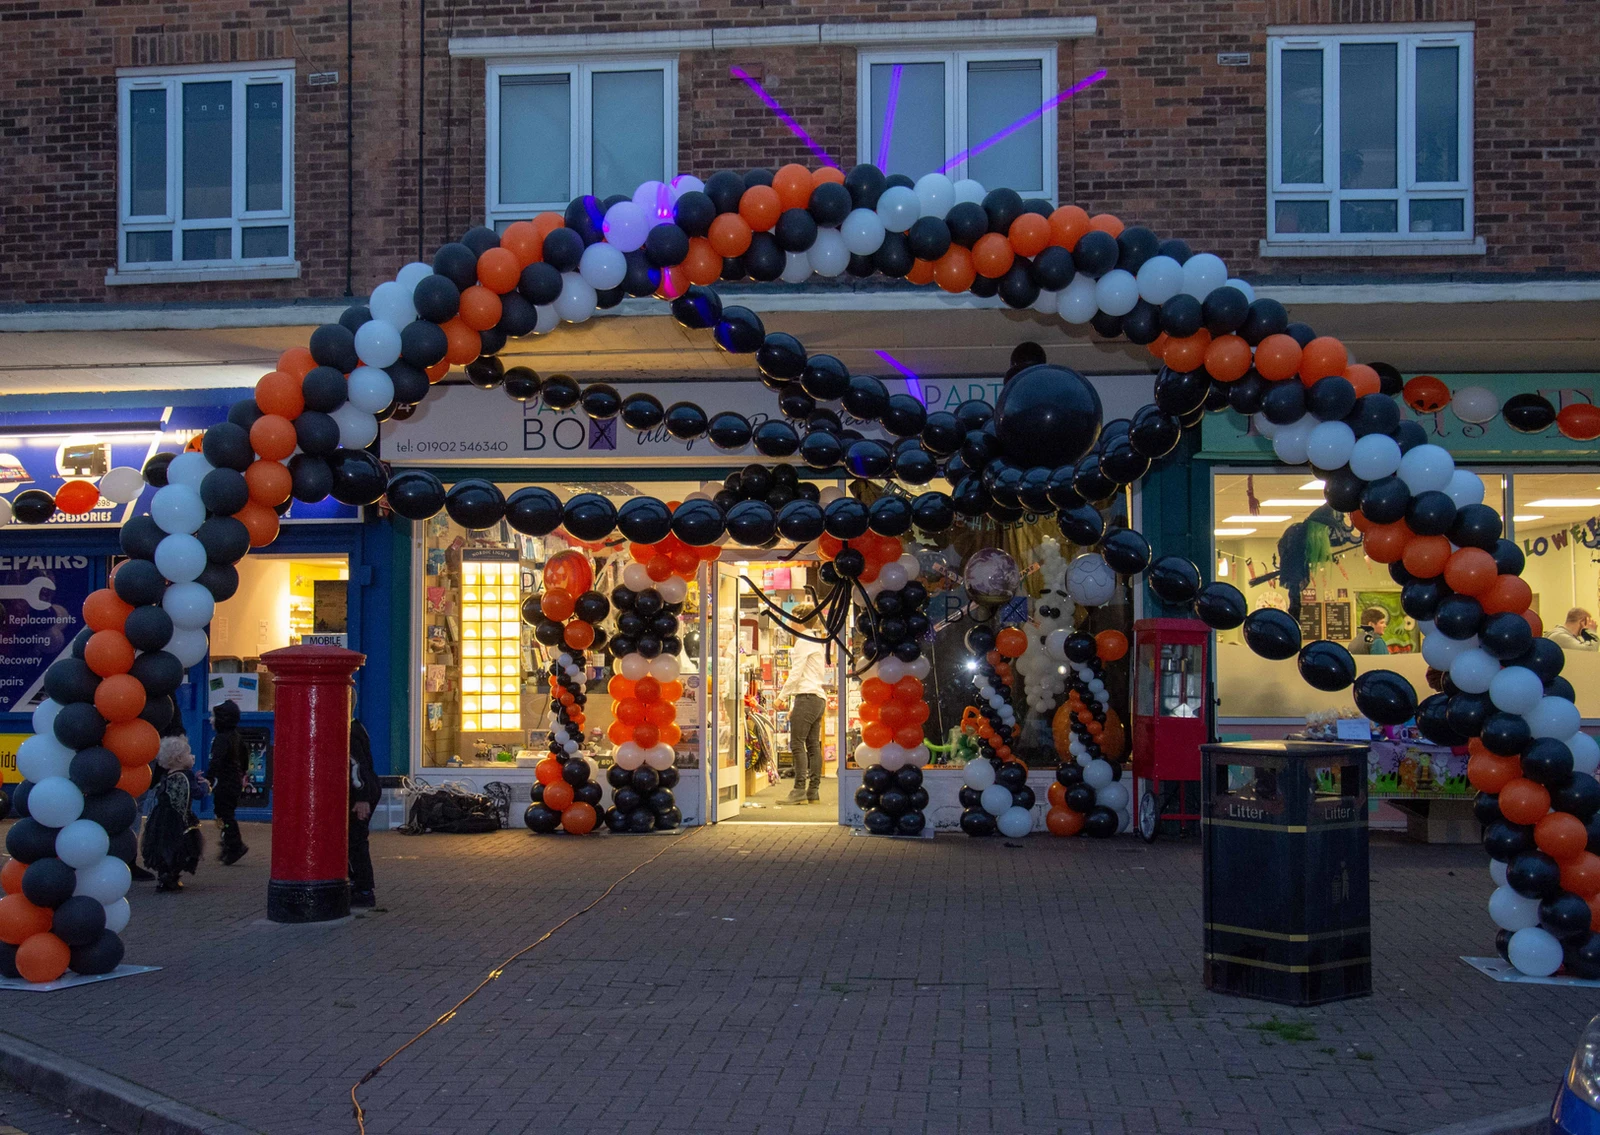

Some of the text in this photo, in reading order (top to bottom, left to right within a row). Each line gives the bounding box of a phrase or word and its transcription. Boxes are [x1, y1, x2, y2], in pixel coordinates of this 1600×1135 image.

[925, 383, 1005, 410] PART
[523, 417, 617, 451] BOX
[396, 439, 508, 453] tel: 01902 546340
[46, 511, 112, 523] CCESSORIES
[9, 614, 77, 626] Replacements
[309, 636, 341, 645] MOBILE
[0, 656, 43, 665] Recovery
[1229, 803, 1264, 819] Litter
[1324, 806, 1351, 820] Litter
